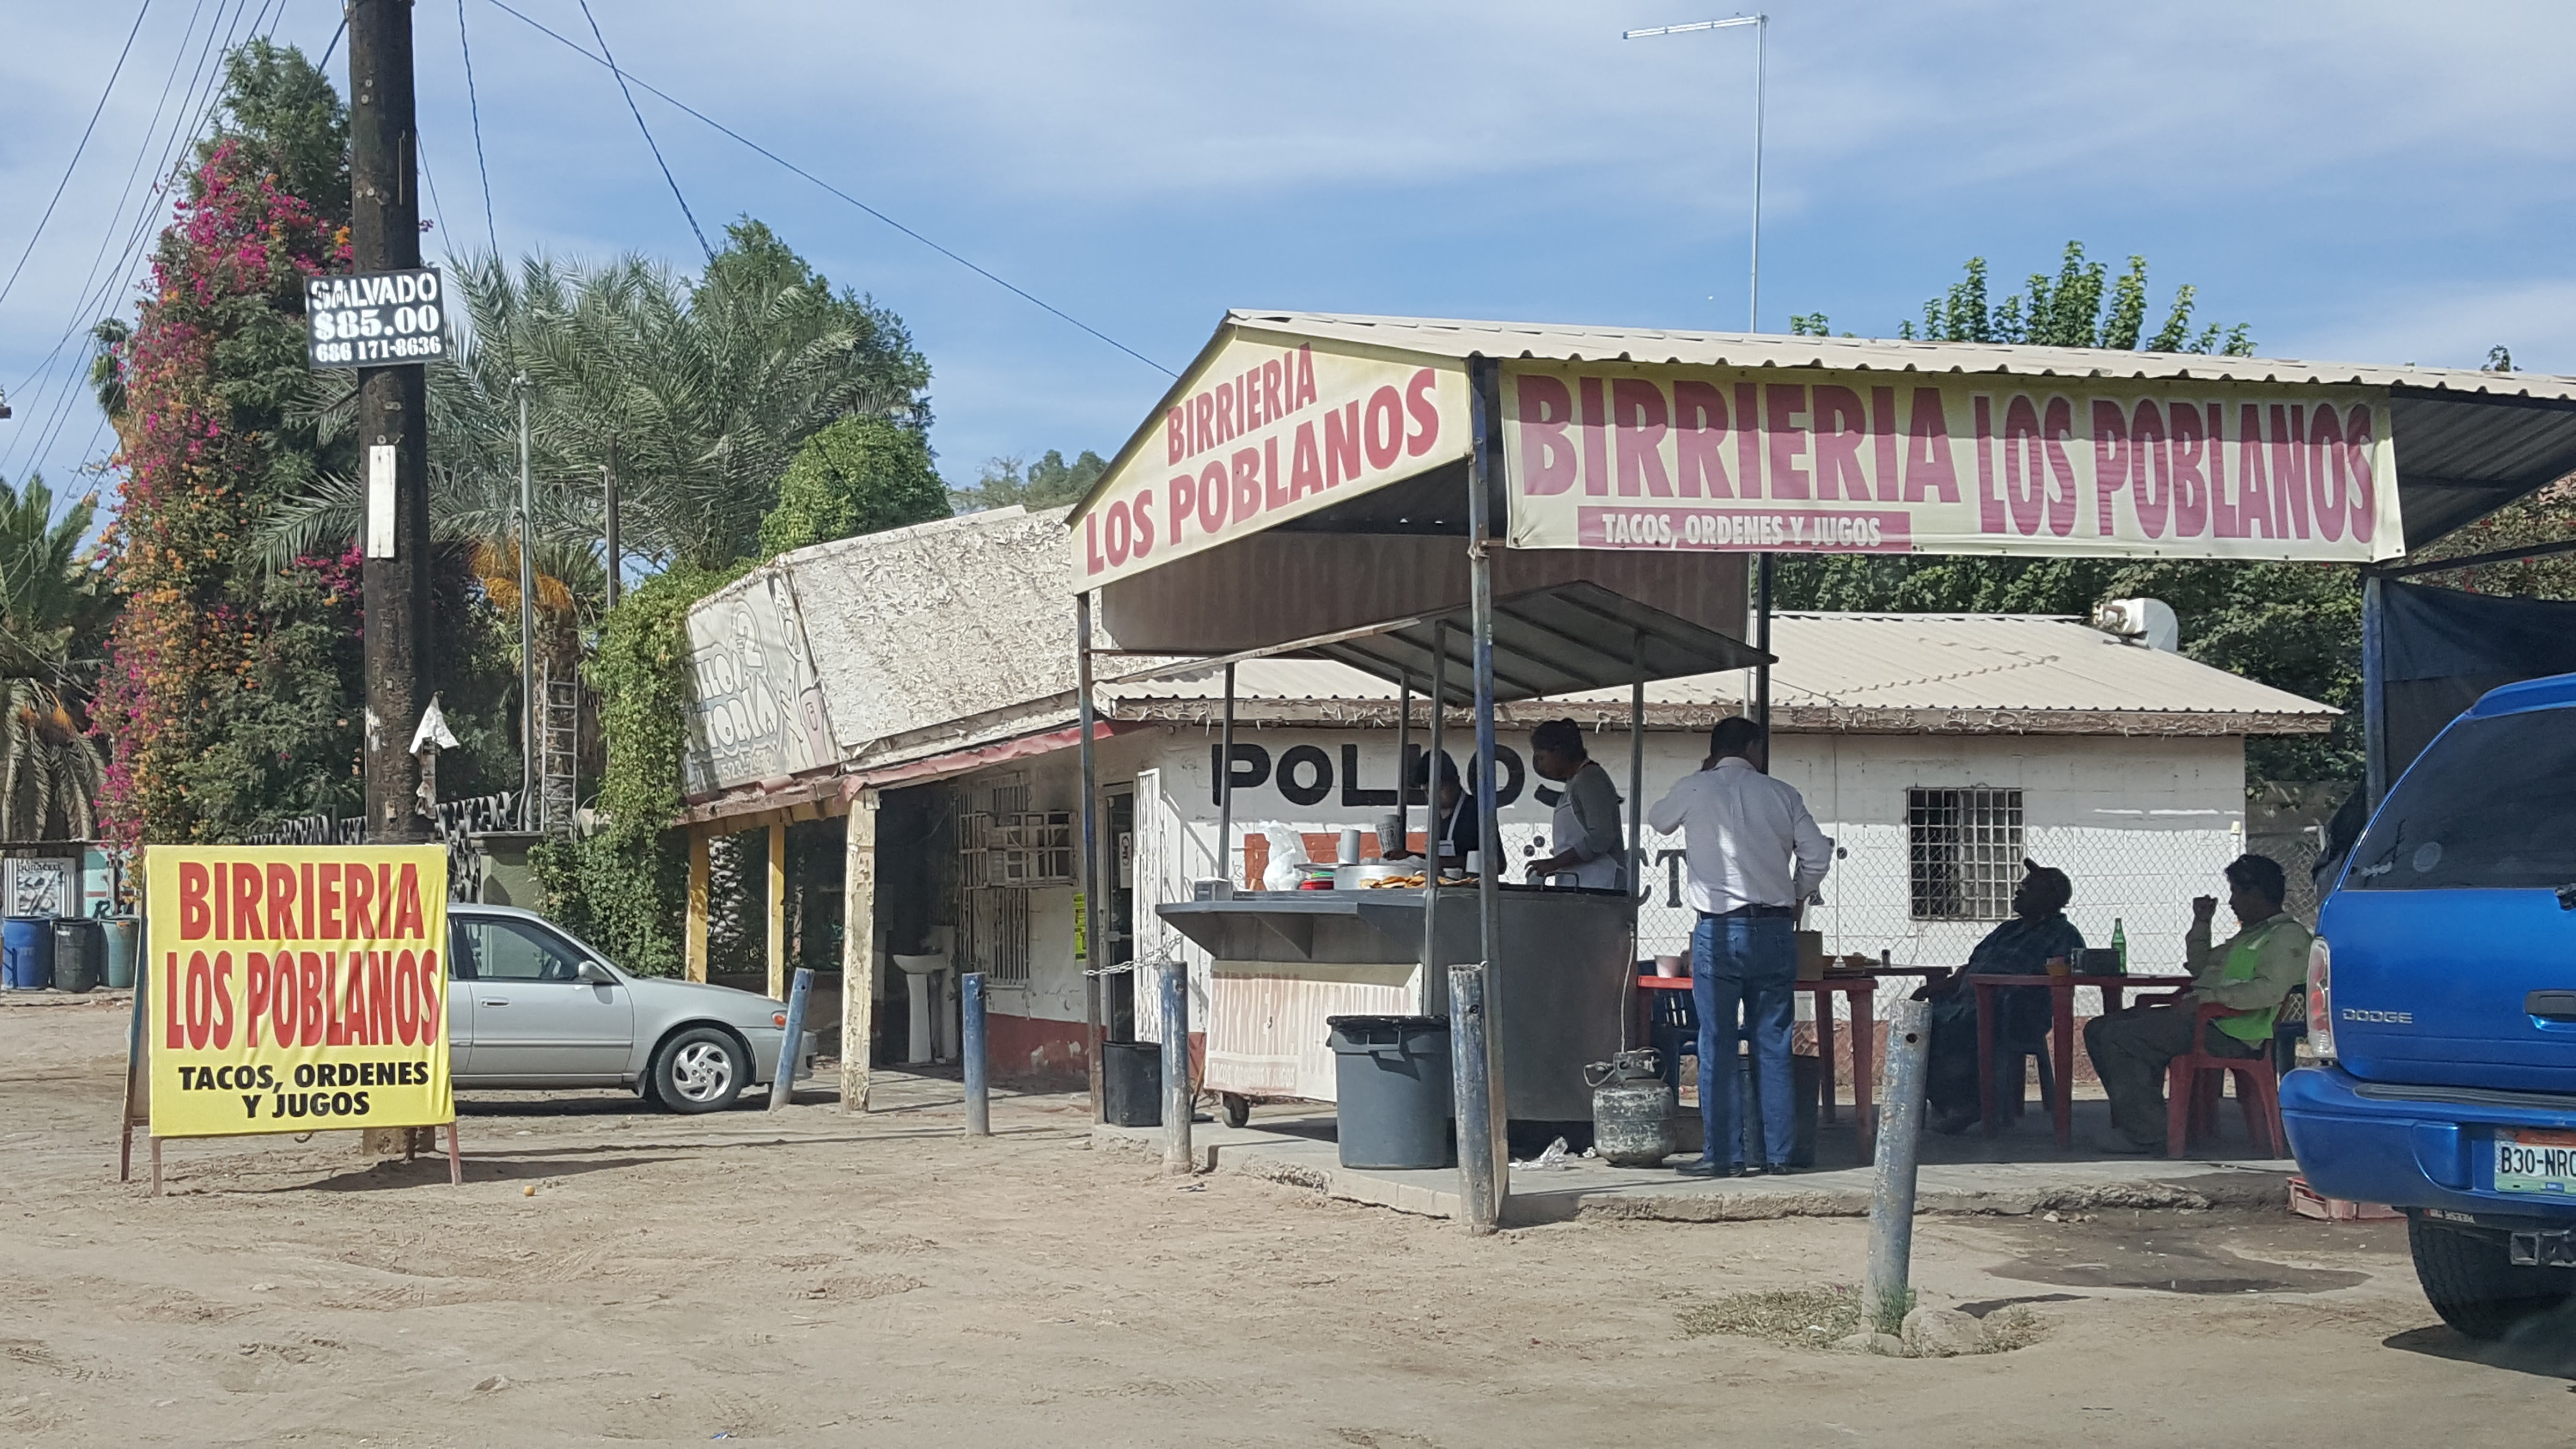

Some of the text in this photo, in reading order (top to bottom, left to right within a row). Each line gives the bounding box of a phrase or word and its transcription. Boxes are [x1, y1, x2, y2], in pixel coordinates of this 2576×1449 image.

[310, 273, 437, 310] SALVADO
[314, 305, 439, 341] $85.00
[316, 335, 442, 362] 686 171-8636
[1168, 342, 1318, 466] BIRRIERIA
[1087, 368, 1439, 576] LOS POBLANOS
[1517, 375, 2377, 544] BIRRIERIA LOS POBLANOS
[1602, 514, 1882, 550] TACOS, ORDENES Y JUGOS
[179, 862, 425, 940] BIRRIERIA
[166, 949, 439, 1050] LOS POBLANOS
[2342, 1008, 2413, 1024] DODGE
[178, 1062, 429, 1093] TACOS, ORDENES
[241, 1091, 370, 1118] Y JUGOS
